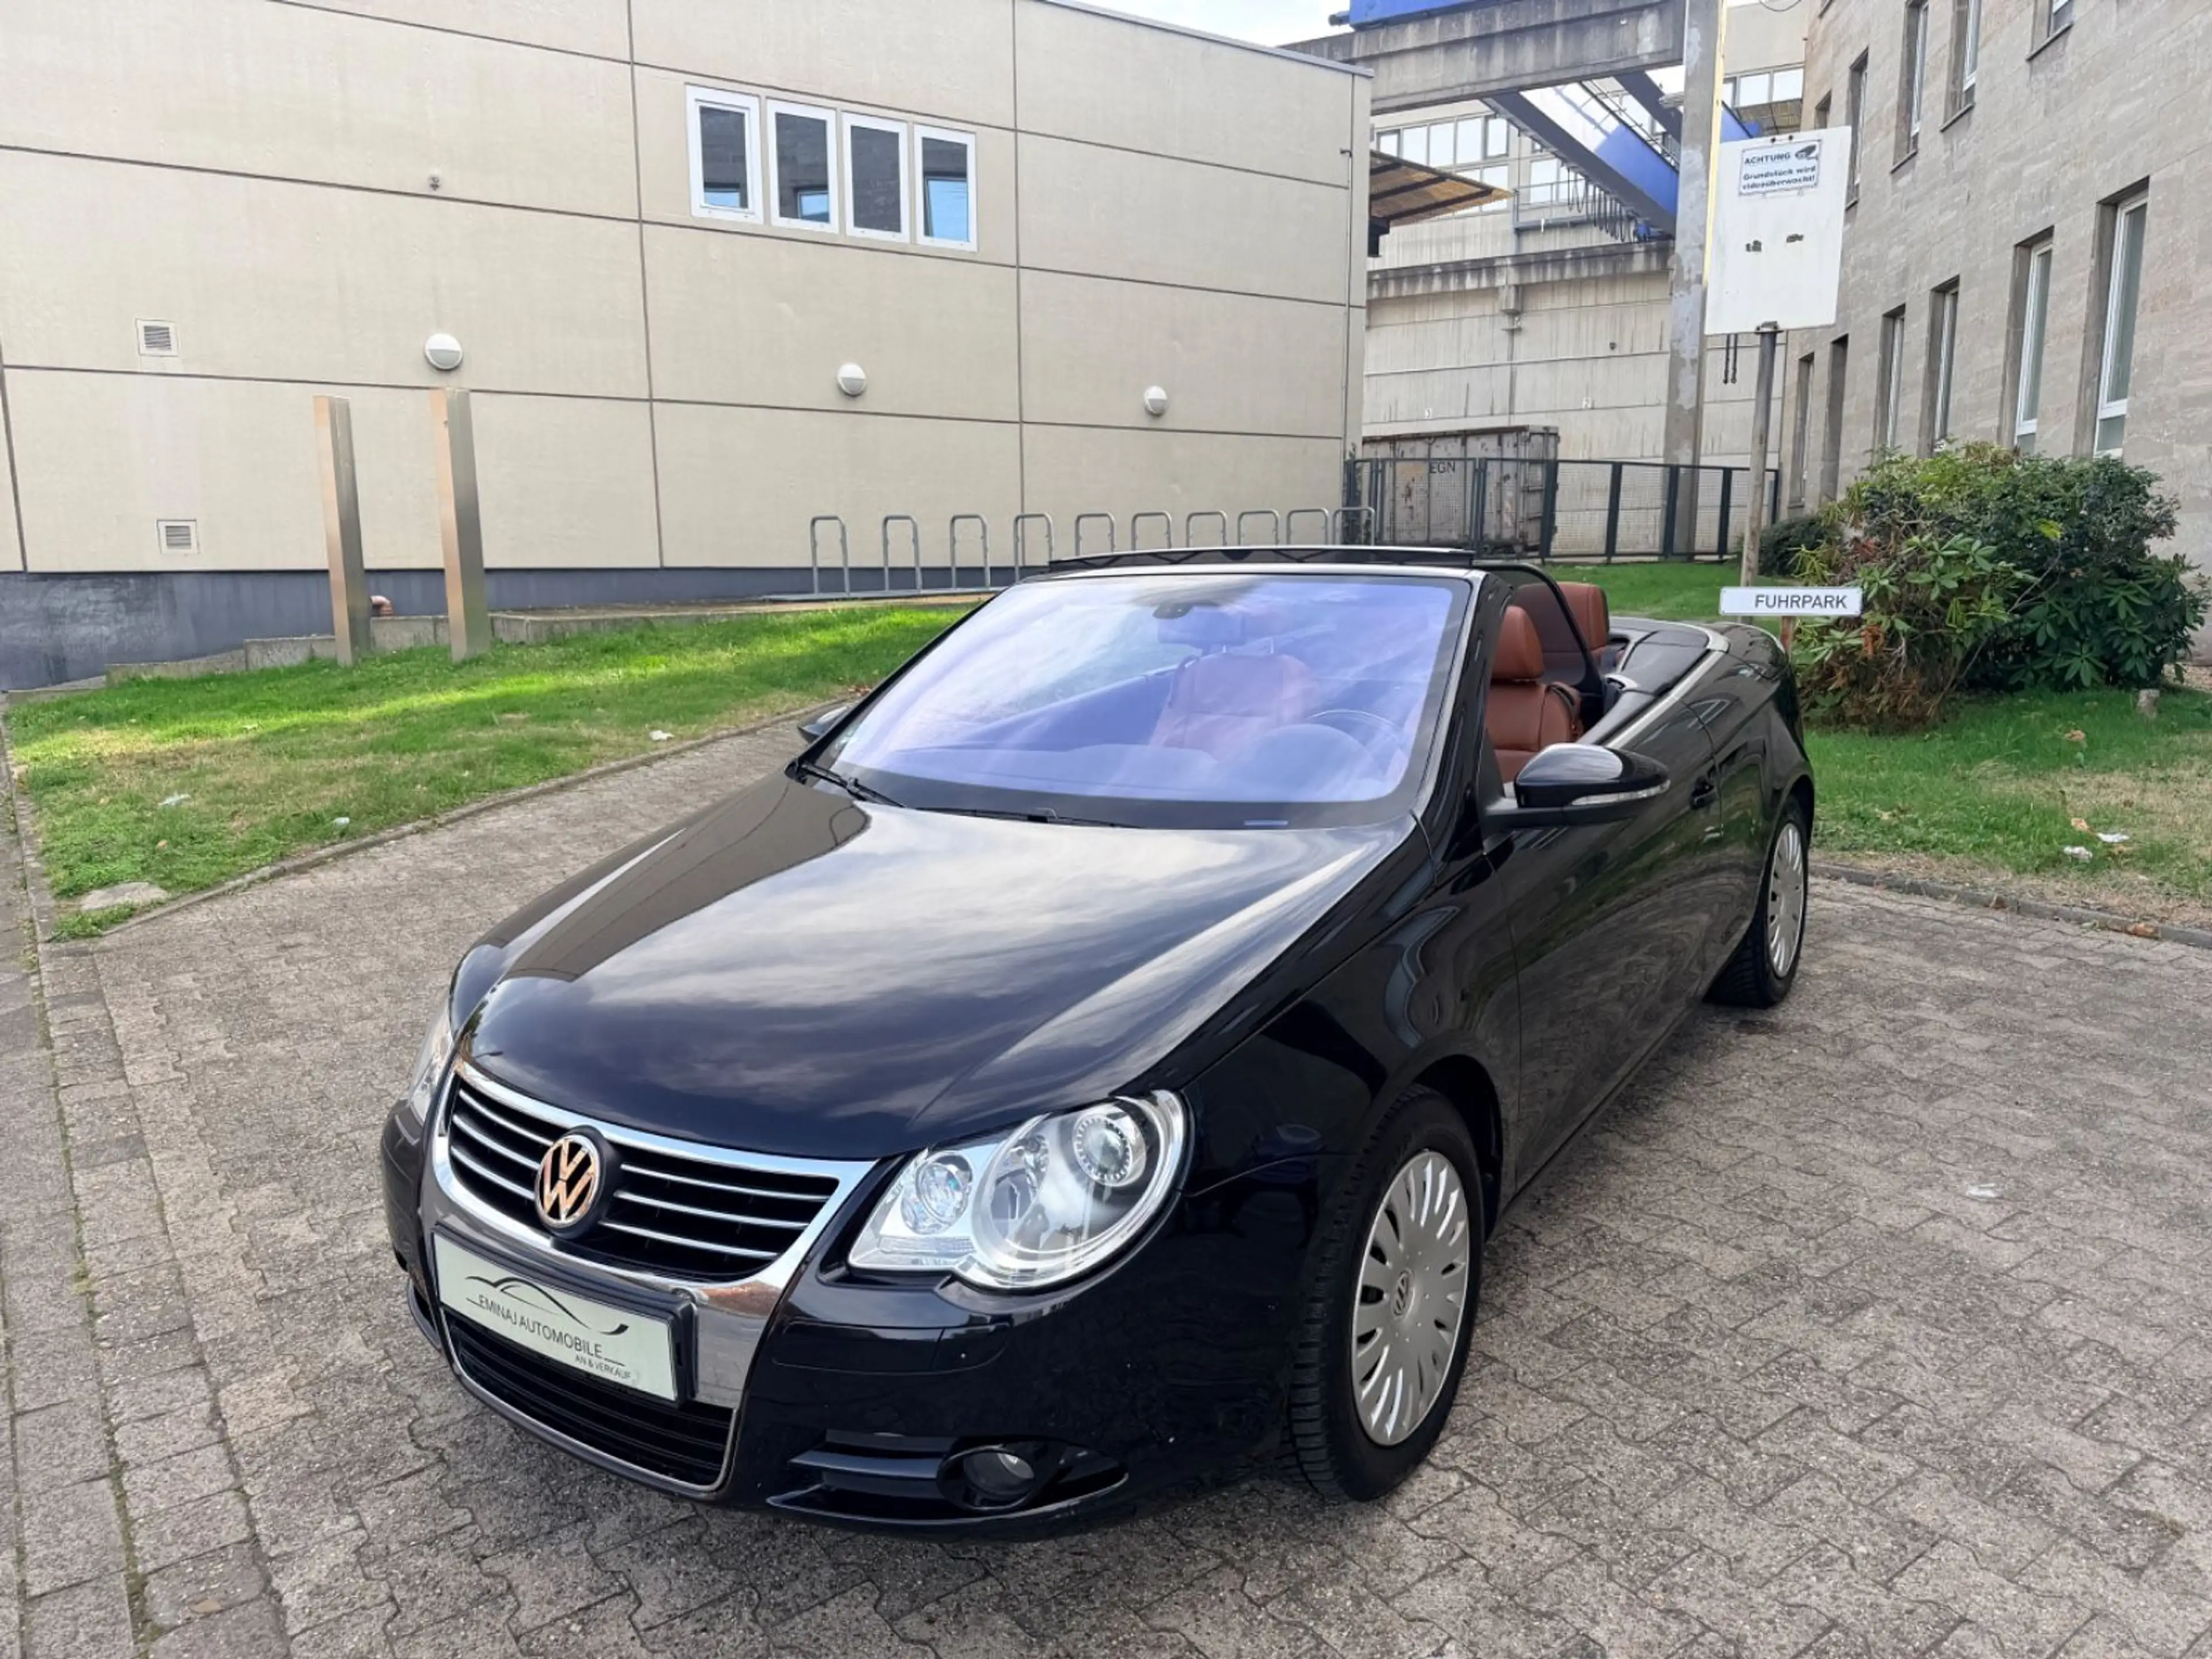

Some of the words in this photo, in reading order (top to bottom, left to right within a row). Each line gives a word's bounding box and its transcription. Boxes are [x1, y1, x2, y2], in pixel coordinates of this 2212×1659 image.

[1744, 151, 1790, 164] ACHTUNG
[1796, 165, 1816, 173] wird
[1429, 460, 1455, 474] EGN
[1755, 594, 1847, 609] FUHRPARK
[479, 1294, 517, 1325] EMINAJ
[520, 1316, 603, 1359] AUTOMOBILE
[575, 1354, 586, 1365] AN
